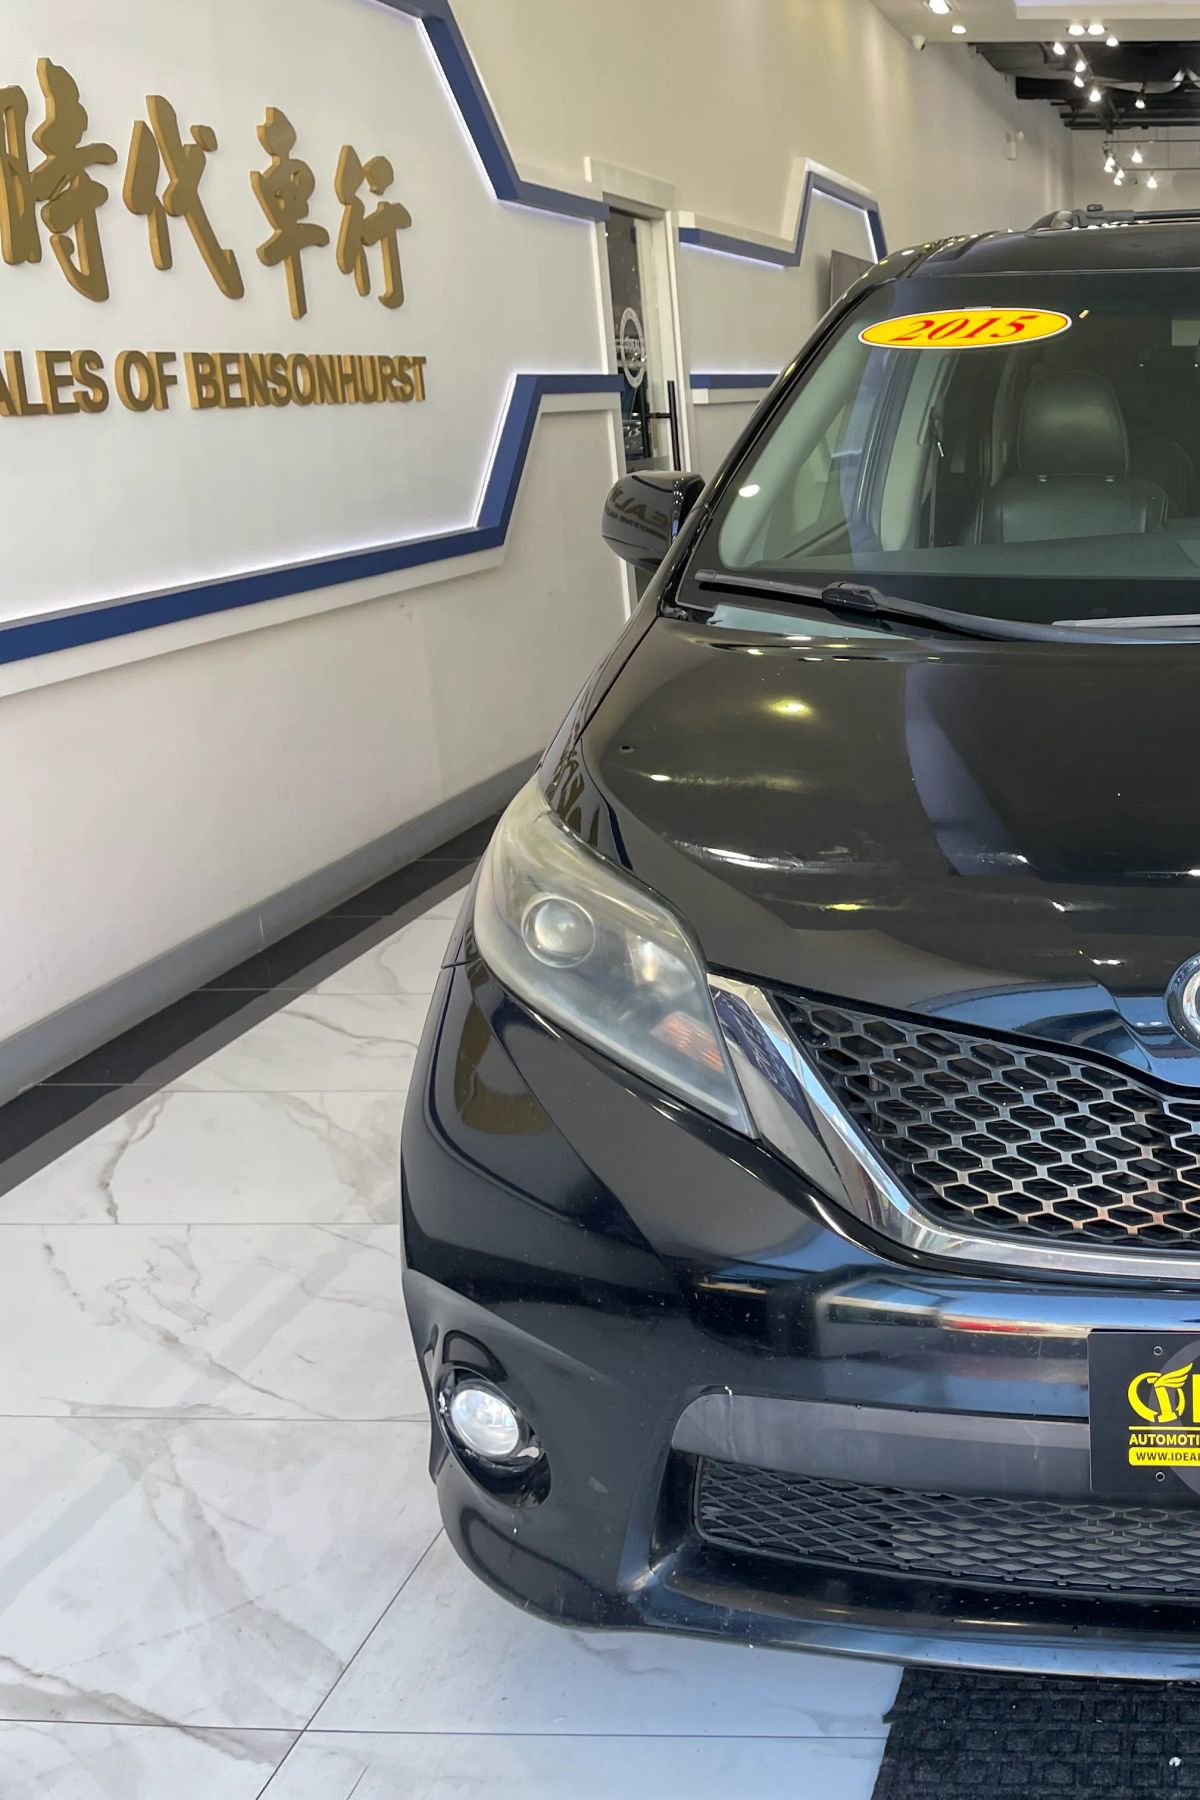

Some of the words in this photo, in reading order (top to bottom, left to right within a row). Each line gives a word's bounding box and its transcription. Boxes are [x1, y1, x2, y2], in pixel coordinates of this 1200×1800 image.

[888, 315, 1039, 342] 2015
[114, 350, 178, 412] OF
[183, 352, 427, 410] BENSONHURST
